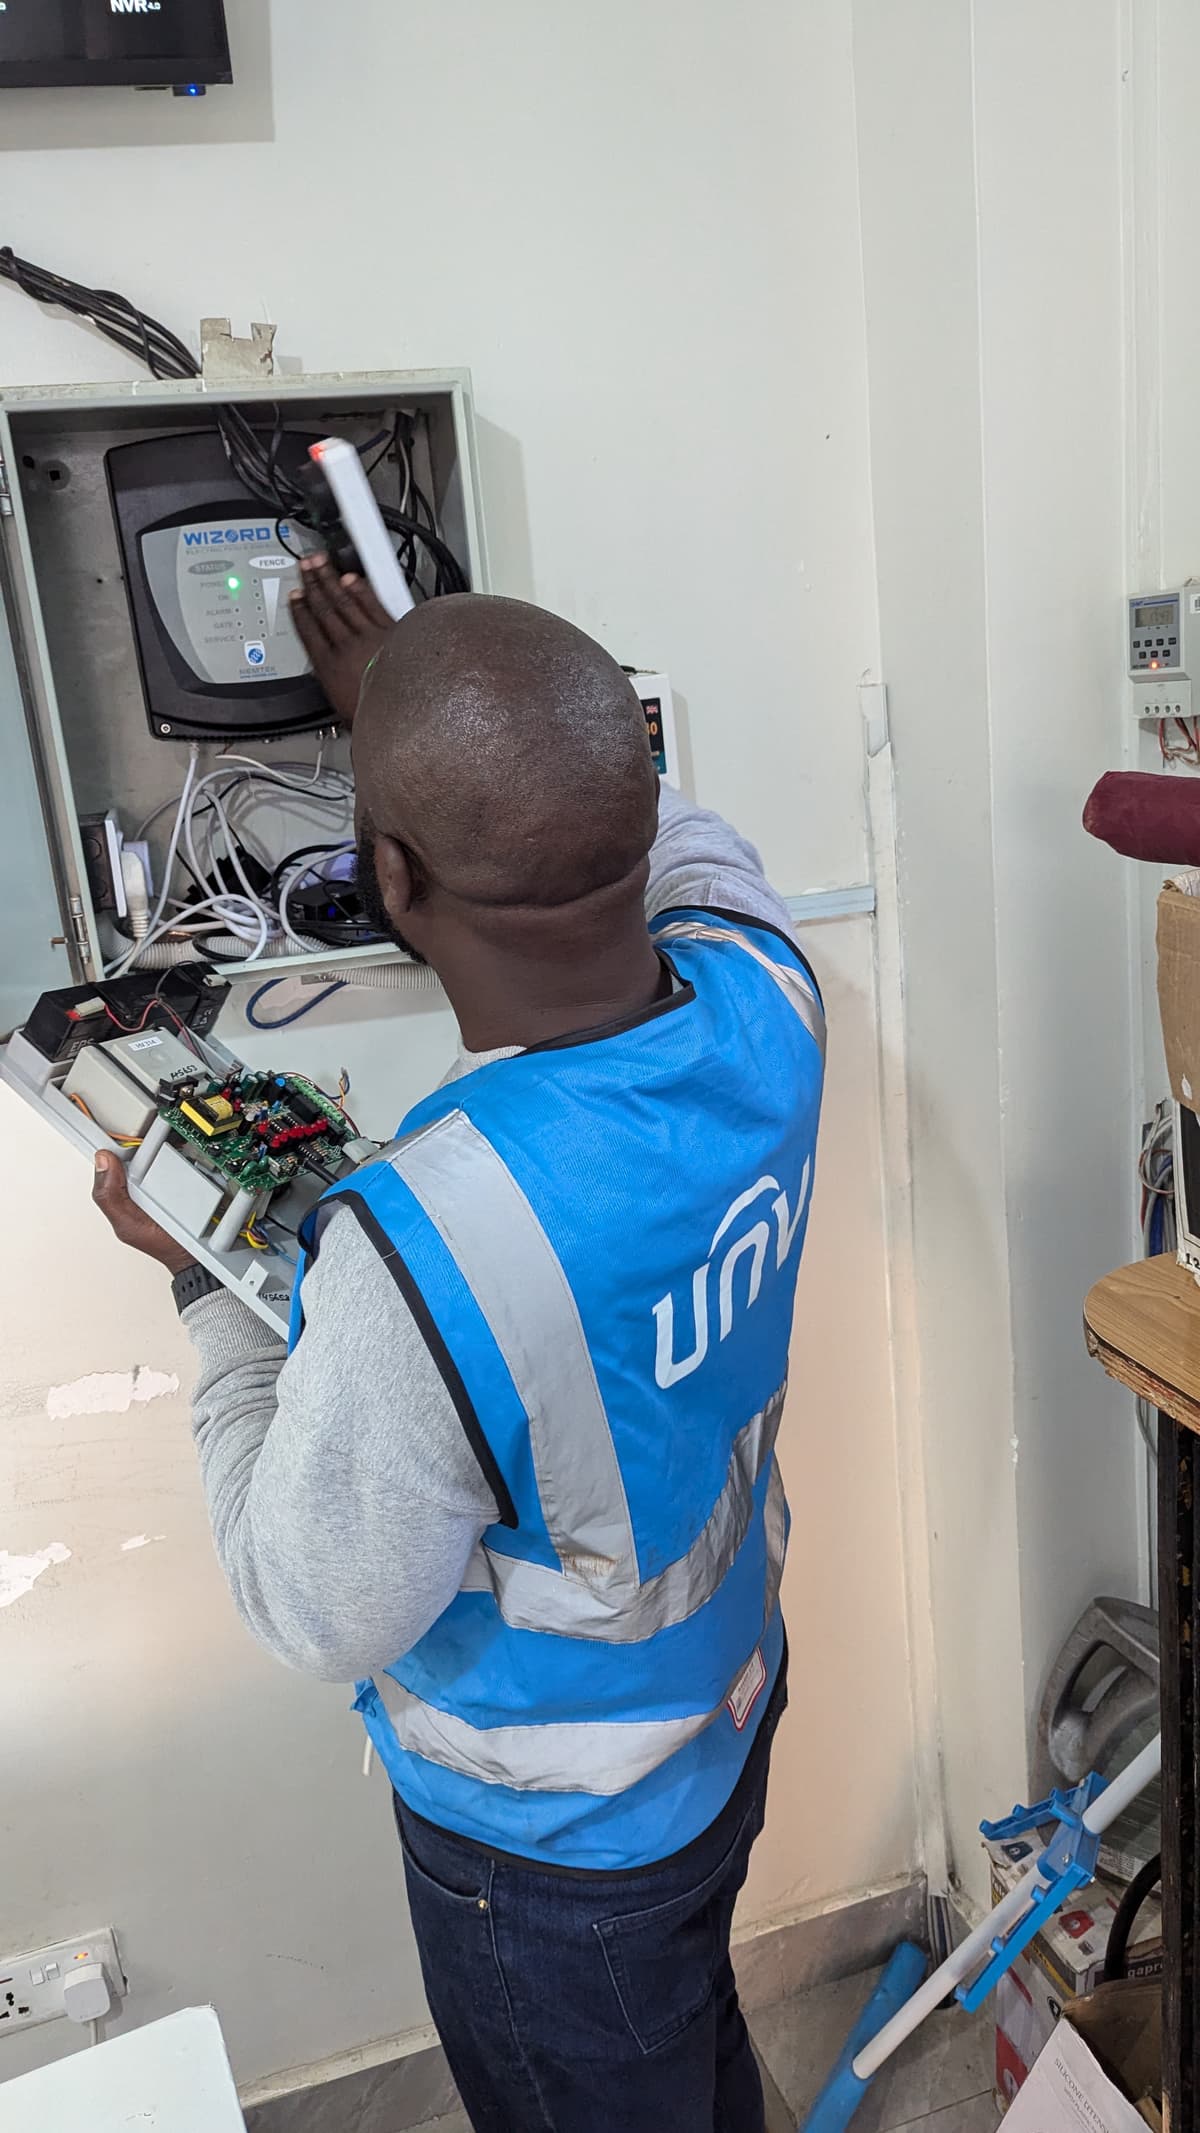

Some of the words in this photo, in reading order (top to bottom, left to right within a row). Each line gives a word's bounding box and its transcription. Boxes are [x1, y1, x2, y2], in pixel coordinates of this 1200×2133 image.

[184, 528, 270, 546] WIZORD
[259, 558, 286, 567] FENCE
[1053, 2057, 1085, 2102] SILICONE
